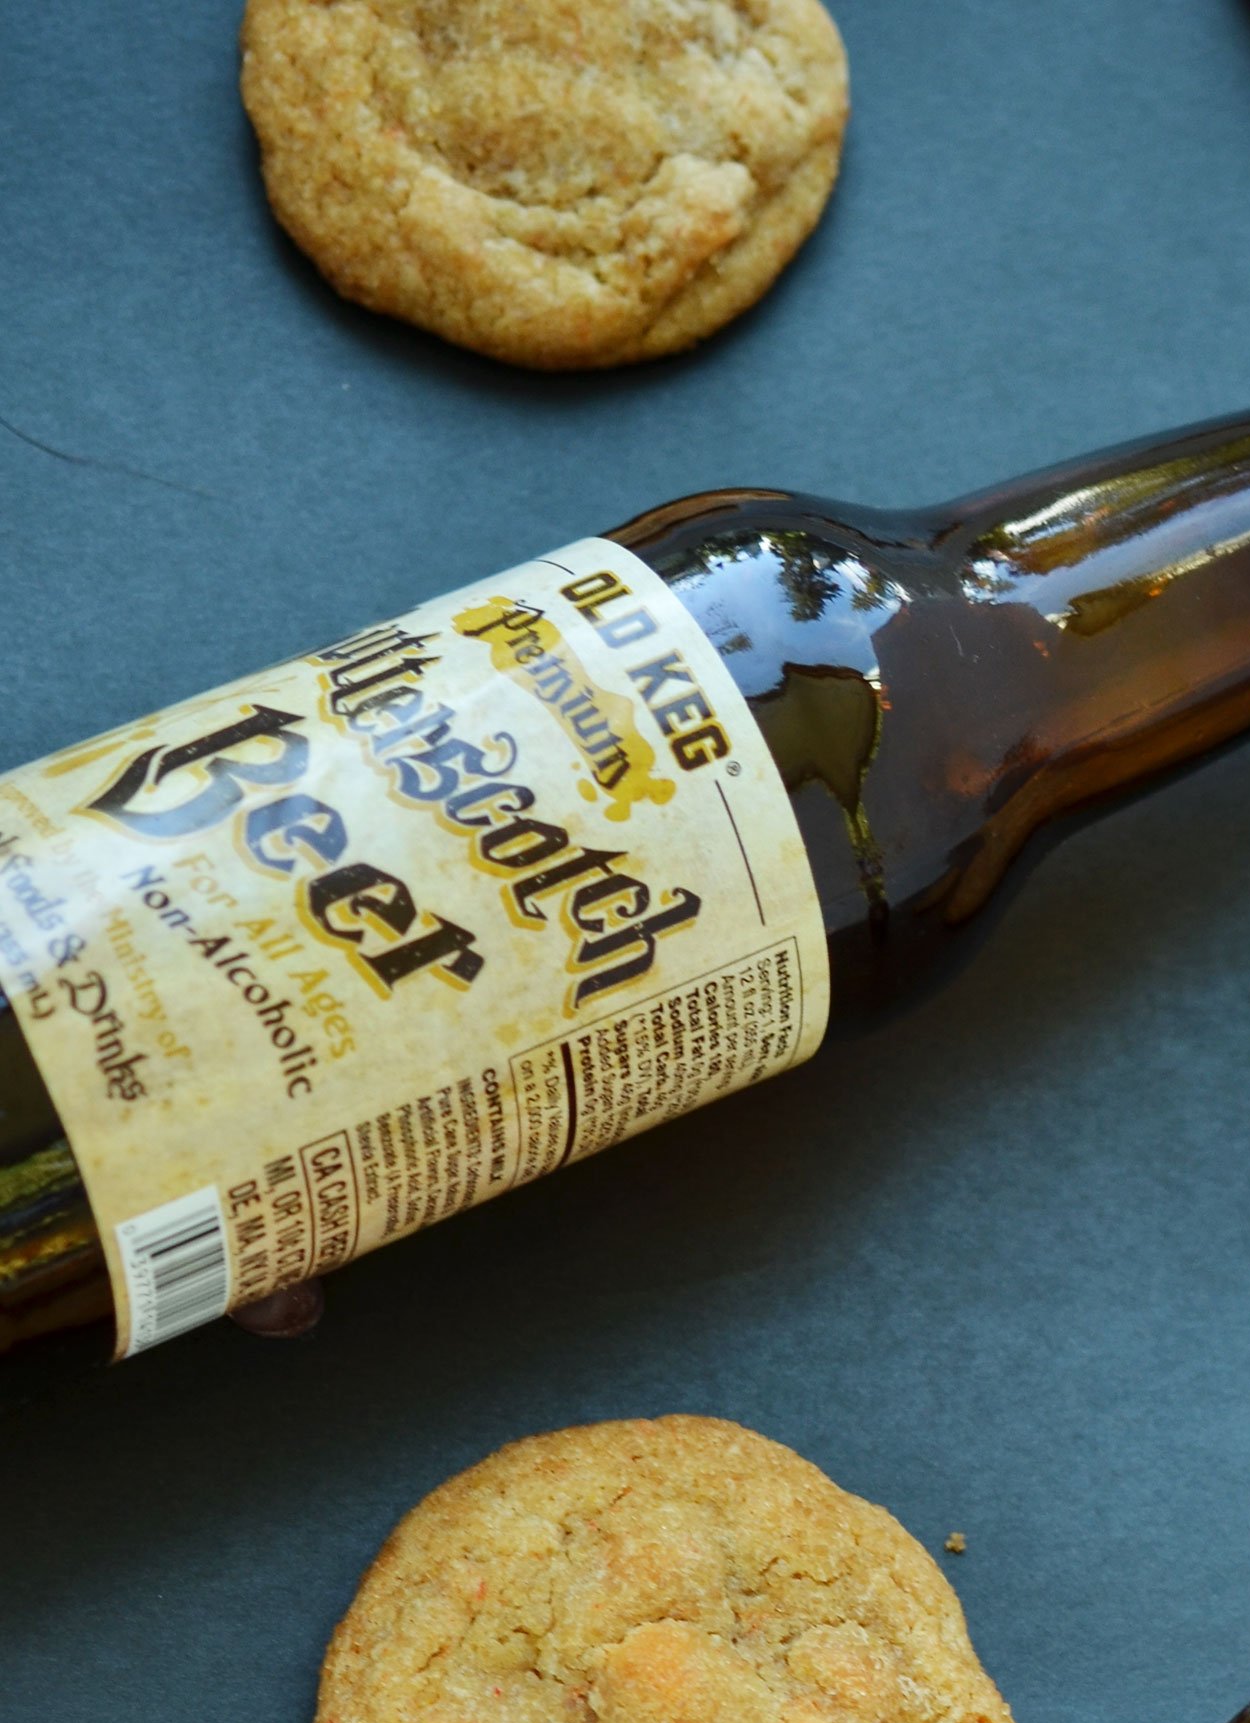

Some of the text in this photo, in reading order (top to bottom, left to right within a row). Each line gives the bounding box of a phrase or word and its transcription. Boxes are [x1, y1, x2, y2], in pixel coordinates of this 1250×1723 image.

[560, 571, 657, 648] OLD
[463, 599, 631, 791] Premium
[318, 623, 702, 1010] utterscotch
[86, 702, 485, 991] Beer
[47, 933, 87, 968] &
[173, 853, 356, 1061] For All Ages
[739, 966, 753, 985] 12
[101, 904, 167, 1023] Ministry
[156, 1030, 192, 1060] of
[120, 864, 314, 1099] Non-Alcoholic
[721, 974, 738, 1030] Amount
[774, 951, 792, 1057] Nutrition Facts
[649, 1004, 666, 1047] Total
[667, 996, 687, 1058] Sodium
[685, 988, 702, 1031] Total
[703, 982, 721, 1049] Calories
[743, 1002, 755, 1018] oz
[58, 970, 149, 1103] Drinks
[595, 1027, 611, 1070] Added
[614, 1020, 632, 1079] Sugars
[692, 1036, 705, 1060] Fat
[726, 1033, 737, 1051] per
[519, 1060, 532, 1079] on
[576, 1035, 597, 1095] Protein
[483, 1069, 504, 1152] CONTAINS
[262, 1155, 296, 1194] MI,
[309, 1146, 343, 1182] CA
[227, 1179, 259, 1219] DE,
[272, 1190, 301, 1223] OR
[317, 1180, 347, 1231] CASH
[235, 1216, 265, 1254] MA,
